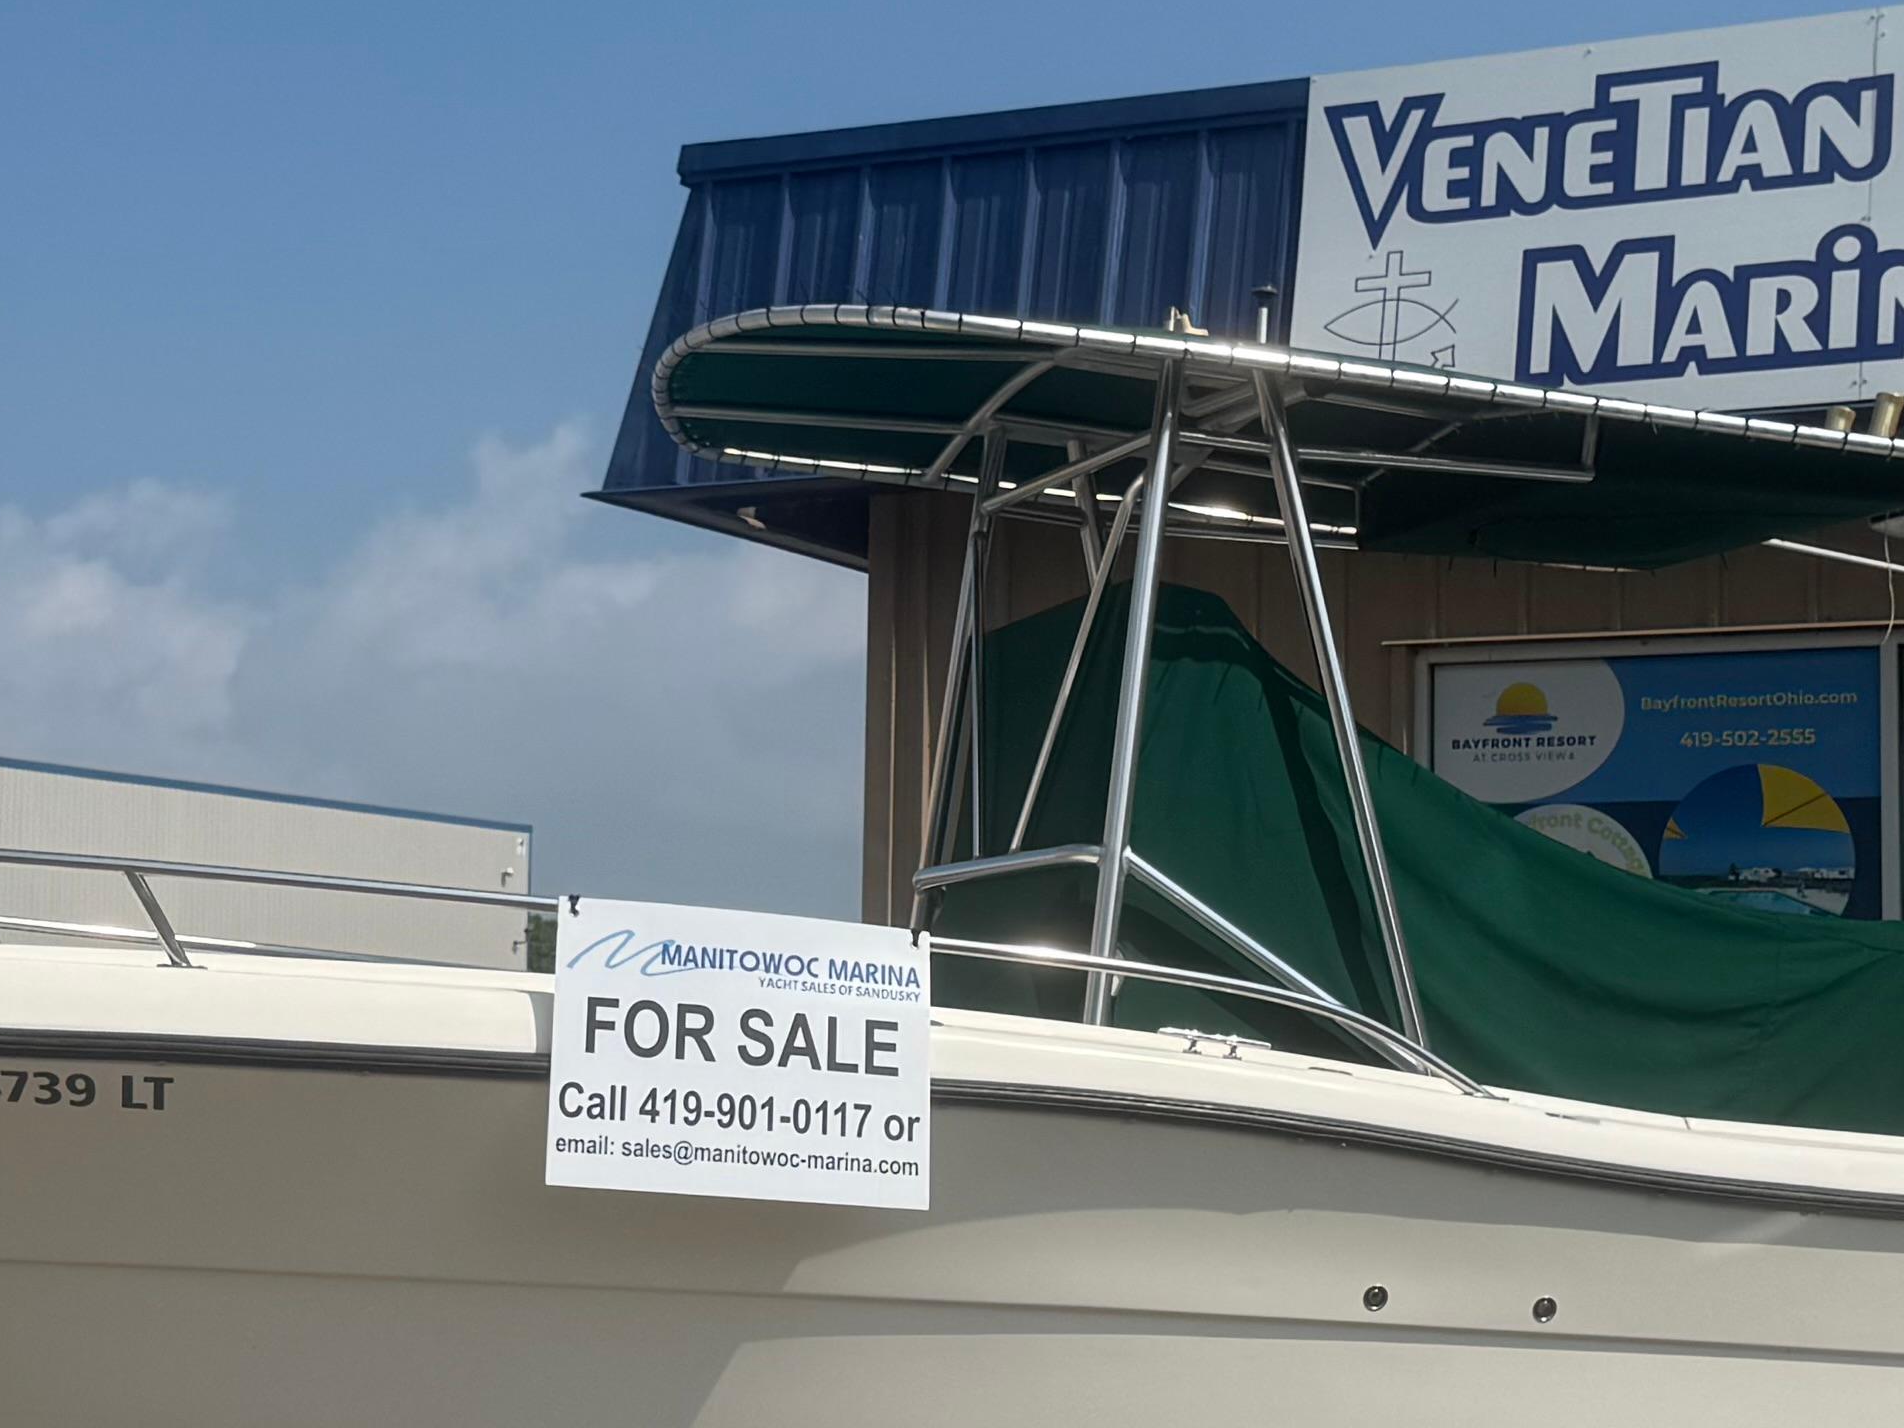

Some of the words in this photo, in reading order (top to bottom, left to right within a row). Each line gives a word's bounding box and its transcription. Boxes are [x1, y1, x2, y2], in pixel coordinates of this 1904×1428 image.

[1452, 737, 1531, 750] BAYFRONT
[1536, 735, 1597, 747] RESORT
[1680, 728, 1816, 748] 419-502-2555
[1473, 754, 1487, 763] AT
[661, 943, 819, 978] MANITOWOC
[828, 958, 921, 989] MARINA
[759, 976, 798, 991] YACHT
[801, 980, 836, 995] SALES
[838, 984, 854, 996] OF
[855, 985, 921, 1003] SANDUSKY
[585, 996, 716, 1063] FOR
[737, 1008, 899, 1077] SALE
[121, 1074, 174, 1111] LT
[559, 1081, 627, 1121] Call
[639, 1087, 872, 1139] 419-901-0117
[884, 1114, 921, 1142] or
[555, 1135, 614, 1155] email:
[621, 1138, 919, 1176] sales@manitowoc-marina.com
